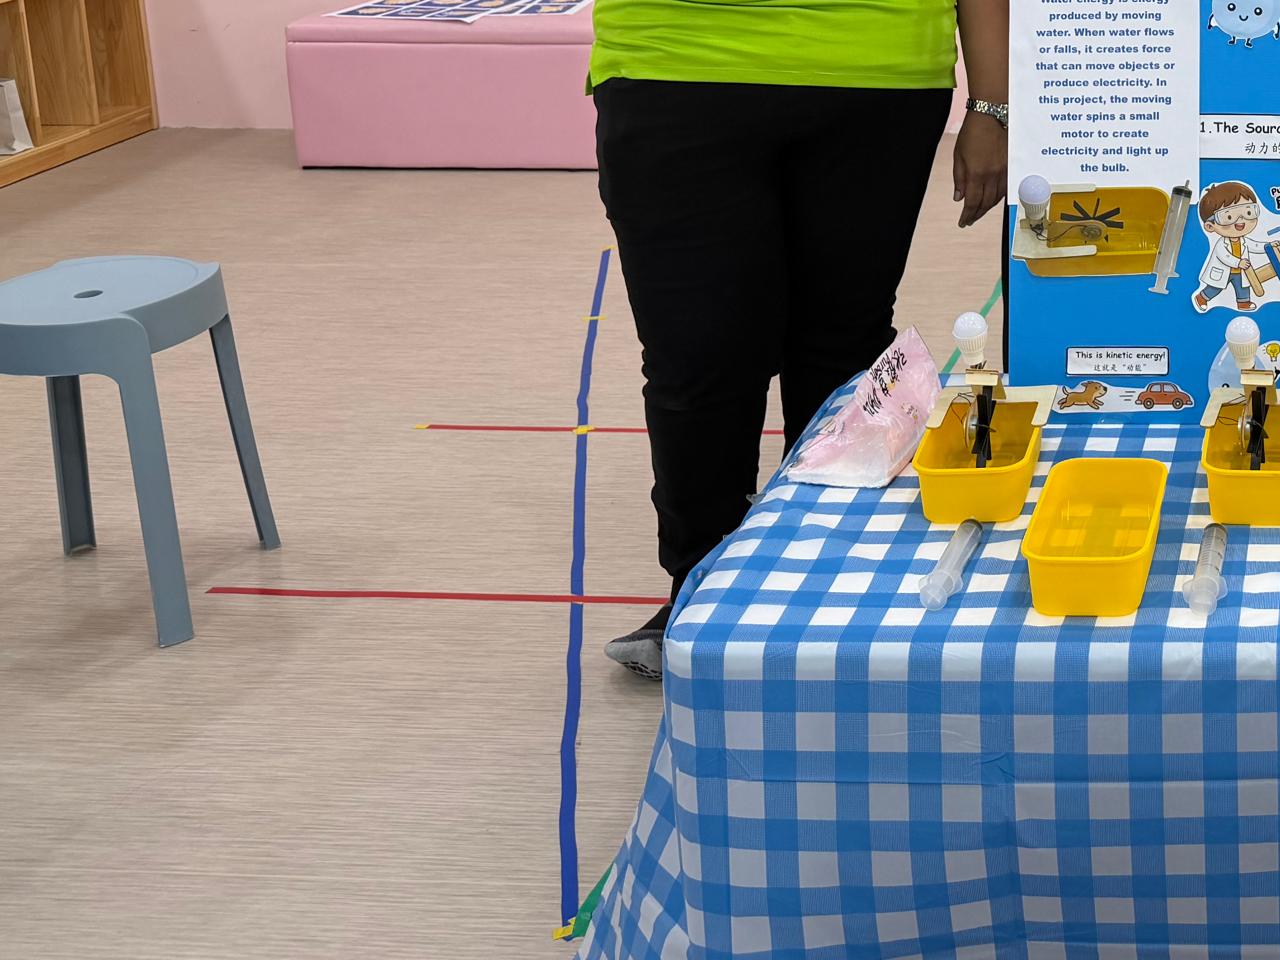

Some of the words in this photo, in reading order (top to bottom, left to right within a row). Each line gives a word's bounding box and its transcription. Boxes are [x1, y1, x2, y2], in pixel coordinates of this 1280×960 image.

[1049, 11, 1101, 22] produced
[1105, 11, 1118, 21] by
[1121, 11, 1162, 21] moving
[1036, 29, 1071, 37] water.
[1074, 28, 1105, 37] When
[1109, 28, 1140, 37] water
[1144, 27, 1174, 36] flows
[1039, 46, 1050, 54] or
[1054, 45, 1082, 55] falls,
[1084, 44, 1093, 53] it
[1096, 45, 1139, 53] creates
[1142, 44, 1171, 53] force
[1036, 61, 1058, 70] that
[1061, 62, 1082, 70] can
[1085, 62, 1115, 70] move
[1118, 61, 1160, 71] objects
[1163, 62, 1175, 70] or
[1043, 78, 1089, 89] produce
[1093, 78, 1153, 88] electricity.
[1156, 78, 1167, 87] In
[1038, 95, 1059, 104] this
[1063, 95, 1107, 105] project,
[1110, 95, 1128, 104] the
[1131, 95, 1172, 105] moving
[1050, 112, 1083, 121] water
[1086, 112, 1116, 122] spins
[1119, 113, 1126, 121] a
[1129, 111, 1160, 120] small
[1200, 122, 1239, 134] 1.The
[1061, 130, 1094, 138] motor
[1097, 130, 1109, 138] to
[1112, 130, 1149, 138] create
[1041, 147, 1099, 157] electricity
[1102, 146, 1122, 155] and
[1126, 146, 1151, 157] light
[1155, 148, 1169, 156] up
[1080, 163, 1099, 172] the
[1102, 163, 1129, 172] bulb.
[1075, 351, 1092, 359] This
[1096, 351, 1103, 359] is
[1106, 351, 1132, 359] kinetic
[1136, 352, 1166, 362] energy!
